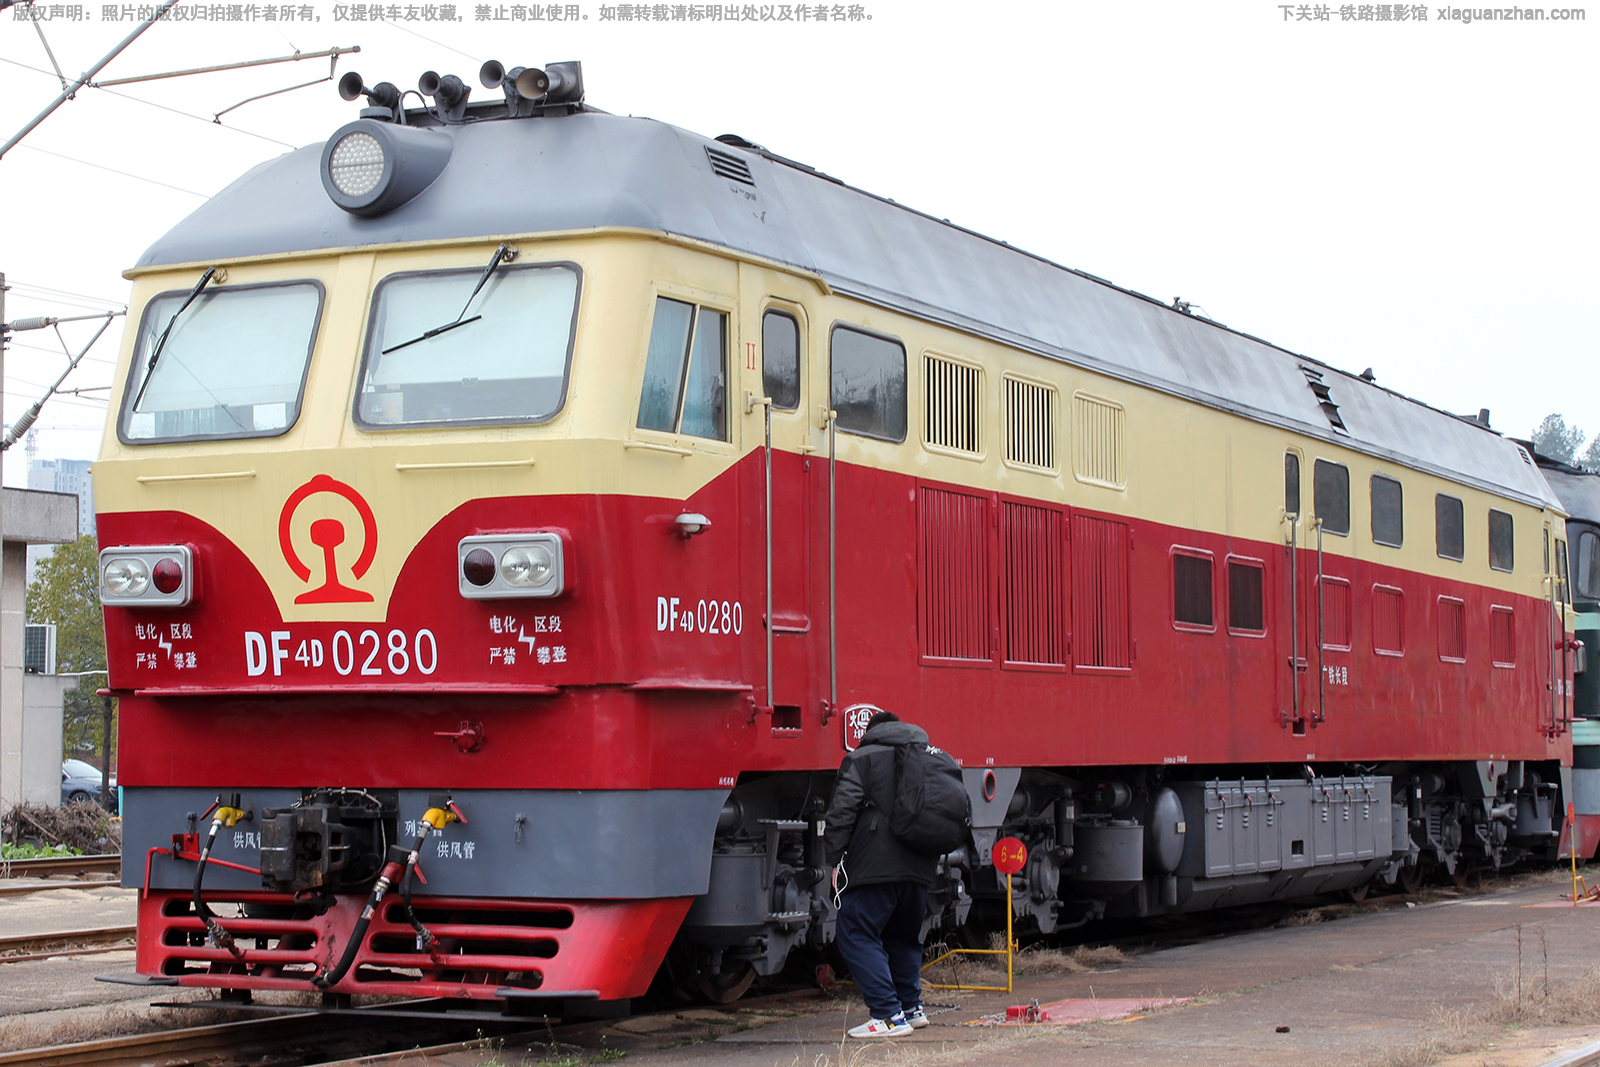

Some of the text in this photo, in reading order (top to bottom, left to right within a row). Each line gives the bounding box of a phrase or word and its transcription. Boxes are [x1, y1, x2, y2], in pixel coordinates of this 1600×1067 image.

[135, 622, 193, 640] 电化 区段
[489, 615, 562, 634] 电化 区段
[136, 651, 198, 670] 严禁 攀登
[489, 645, 567, 665] 严禁 攀登
[436, 840, 476, 860] 供风管
